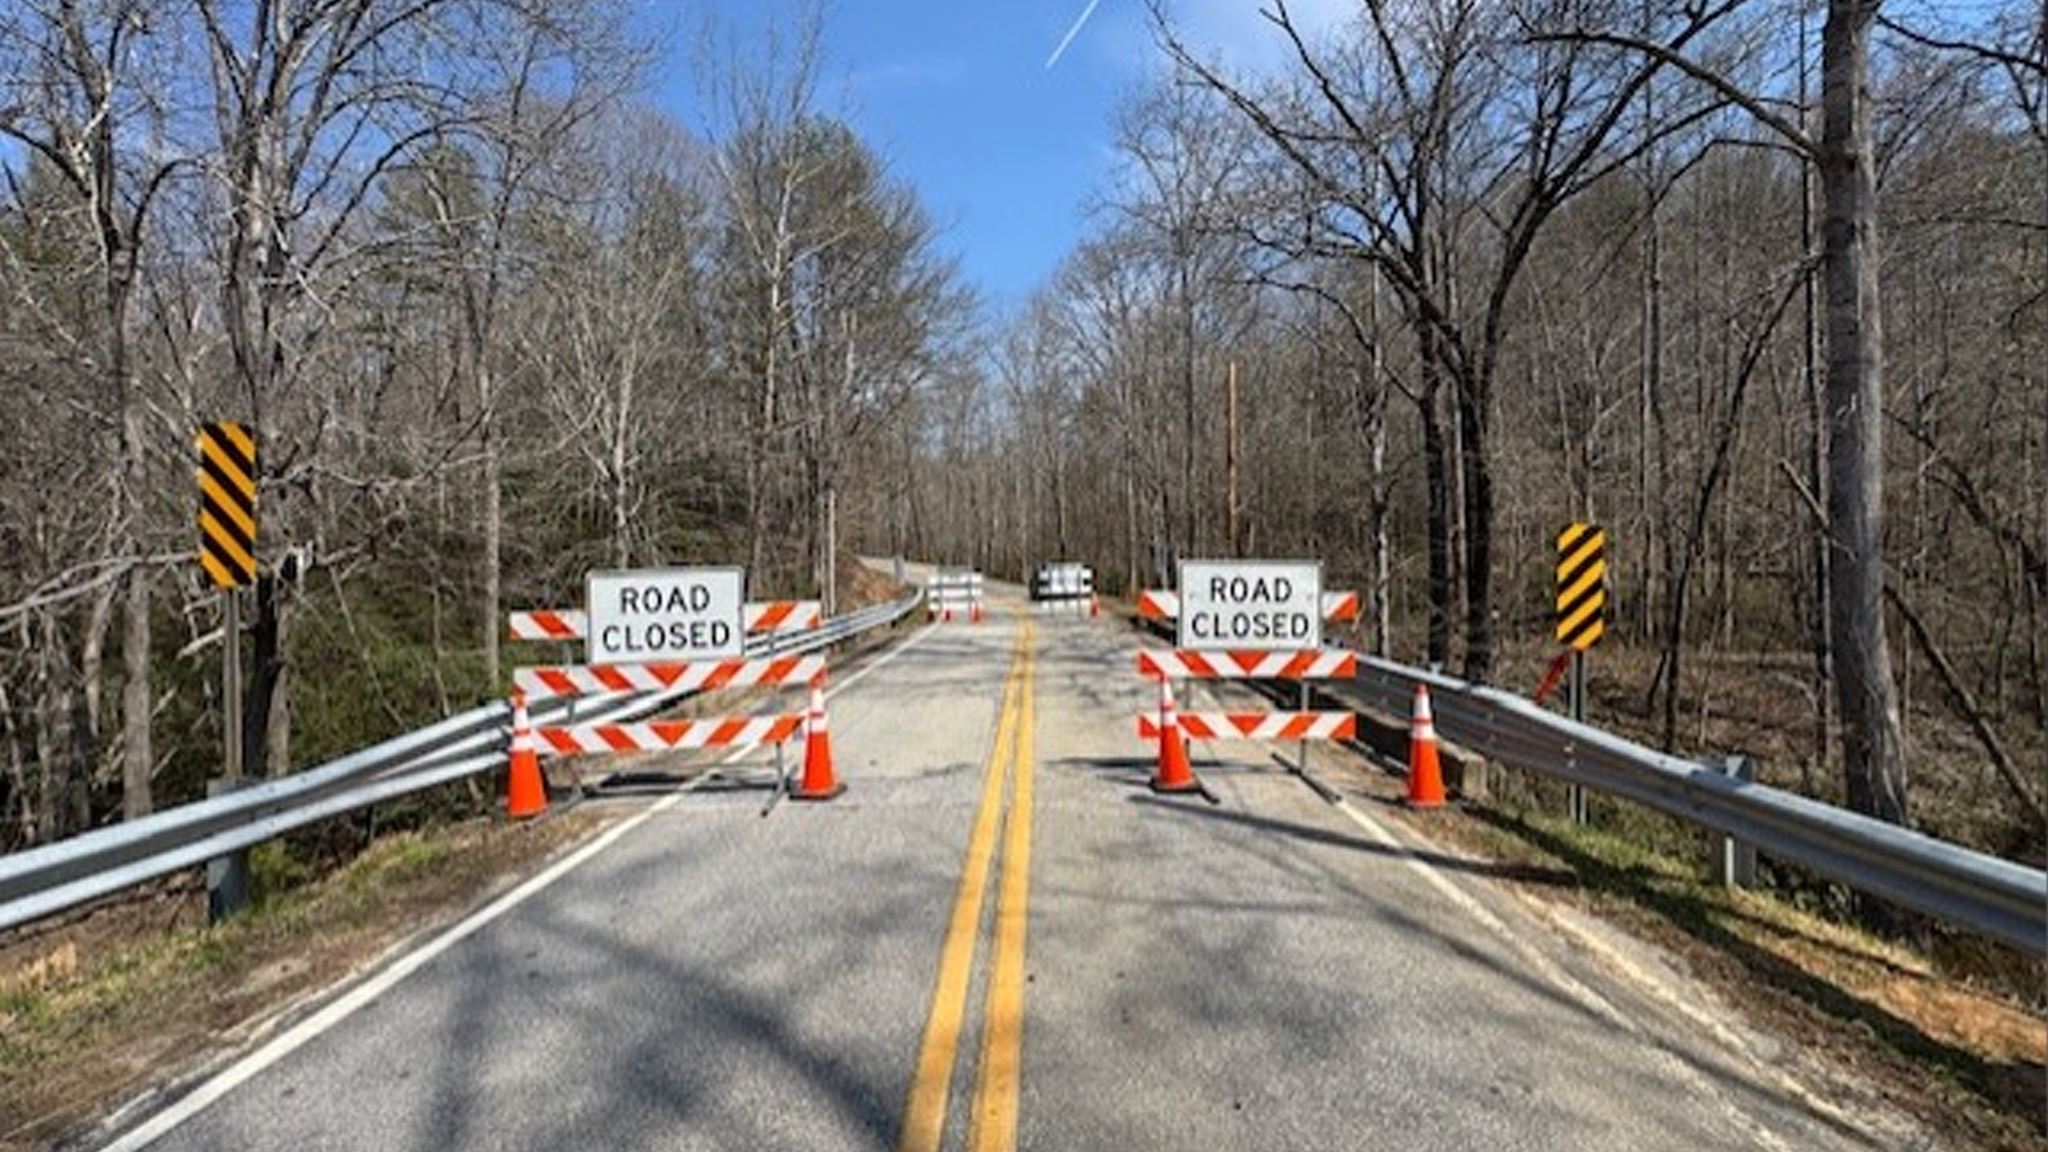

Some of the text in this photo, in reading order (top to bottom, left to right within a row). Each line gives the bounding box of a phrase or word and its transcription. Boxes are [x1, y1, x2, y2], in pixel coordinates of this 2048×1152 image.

[620, 584, 710, 614] ROAD
[1210, 577, 1292, 602] ROAD
[602, 620, 730, 652] CLOSED
[1191, 612, 1309, 638] CLOSED
